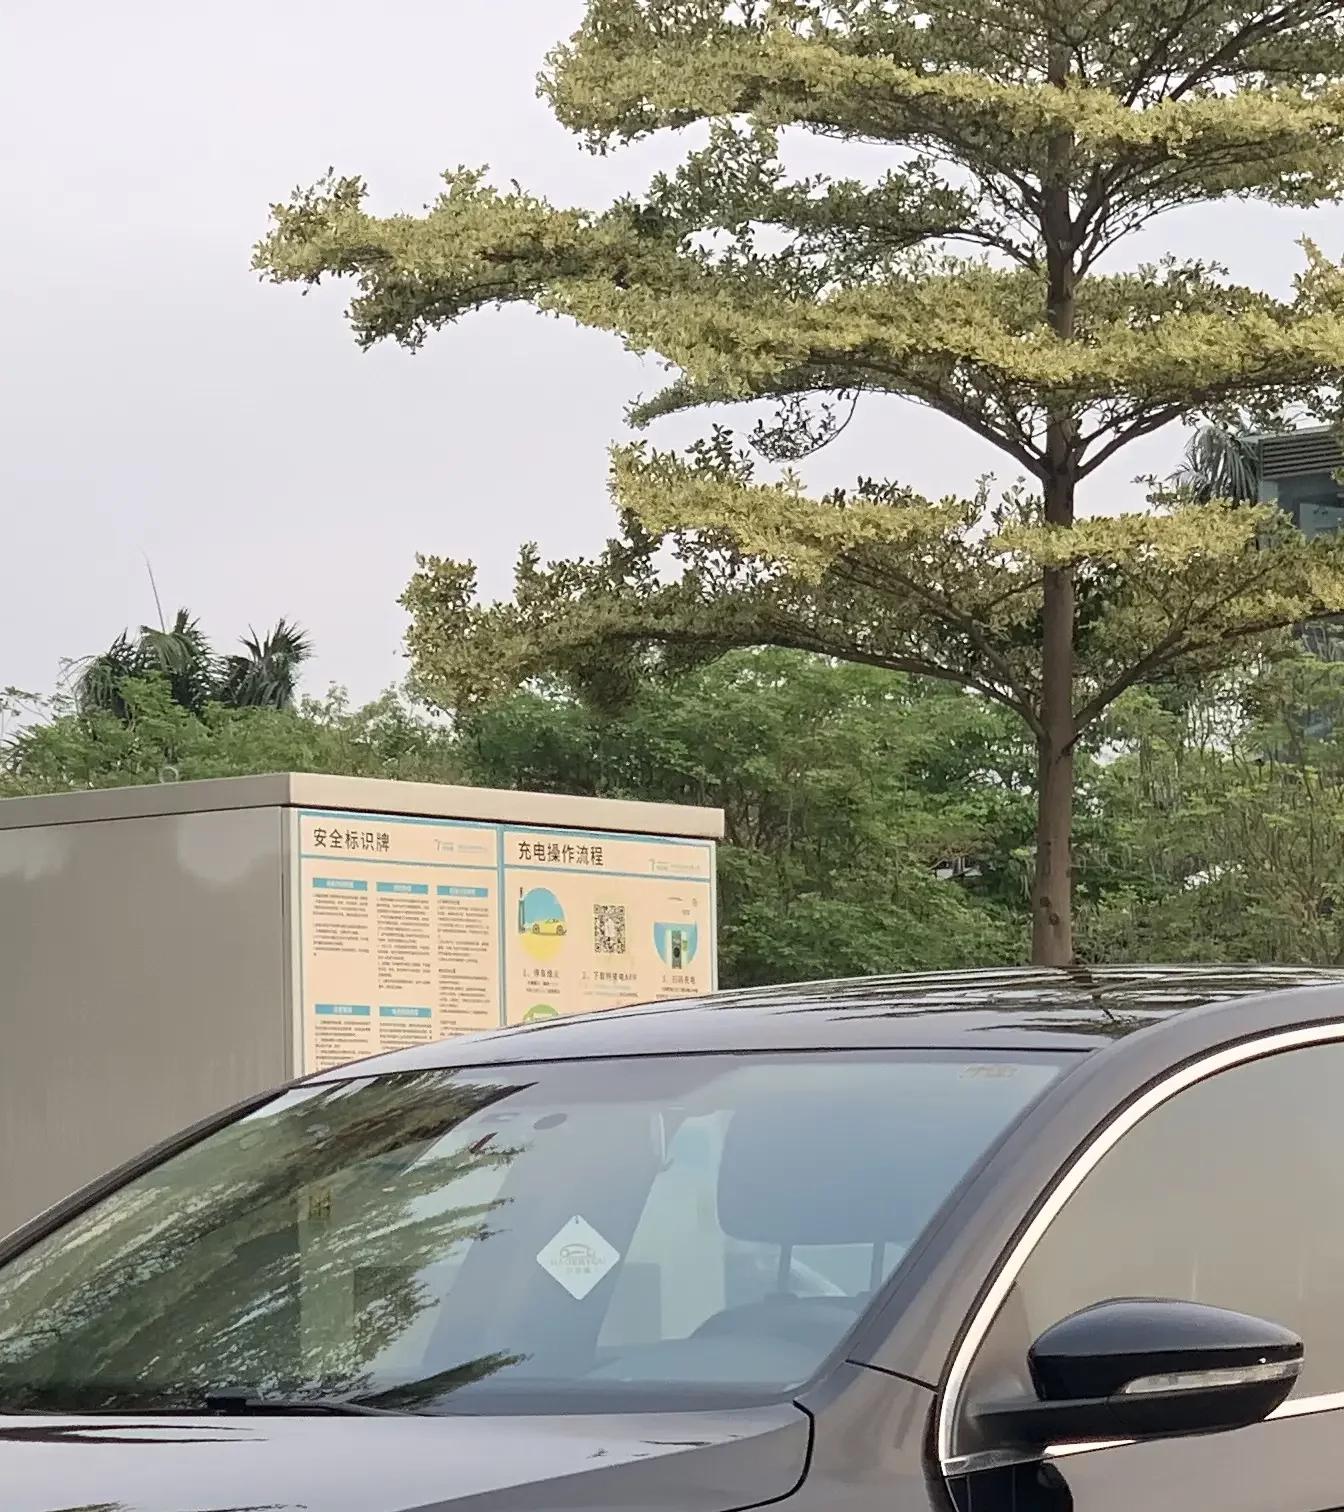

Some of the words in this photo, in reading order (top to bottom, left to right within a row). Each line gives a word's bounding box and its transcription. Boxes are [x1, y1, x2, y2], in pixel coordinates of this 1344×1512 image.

[313, 827, 390, 852] 安全标识牌
[517, 840, 604, 866] 充电操作流程
